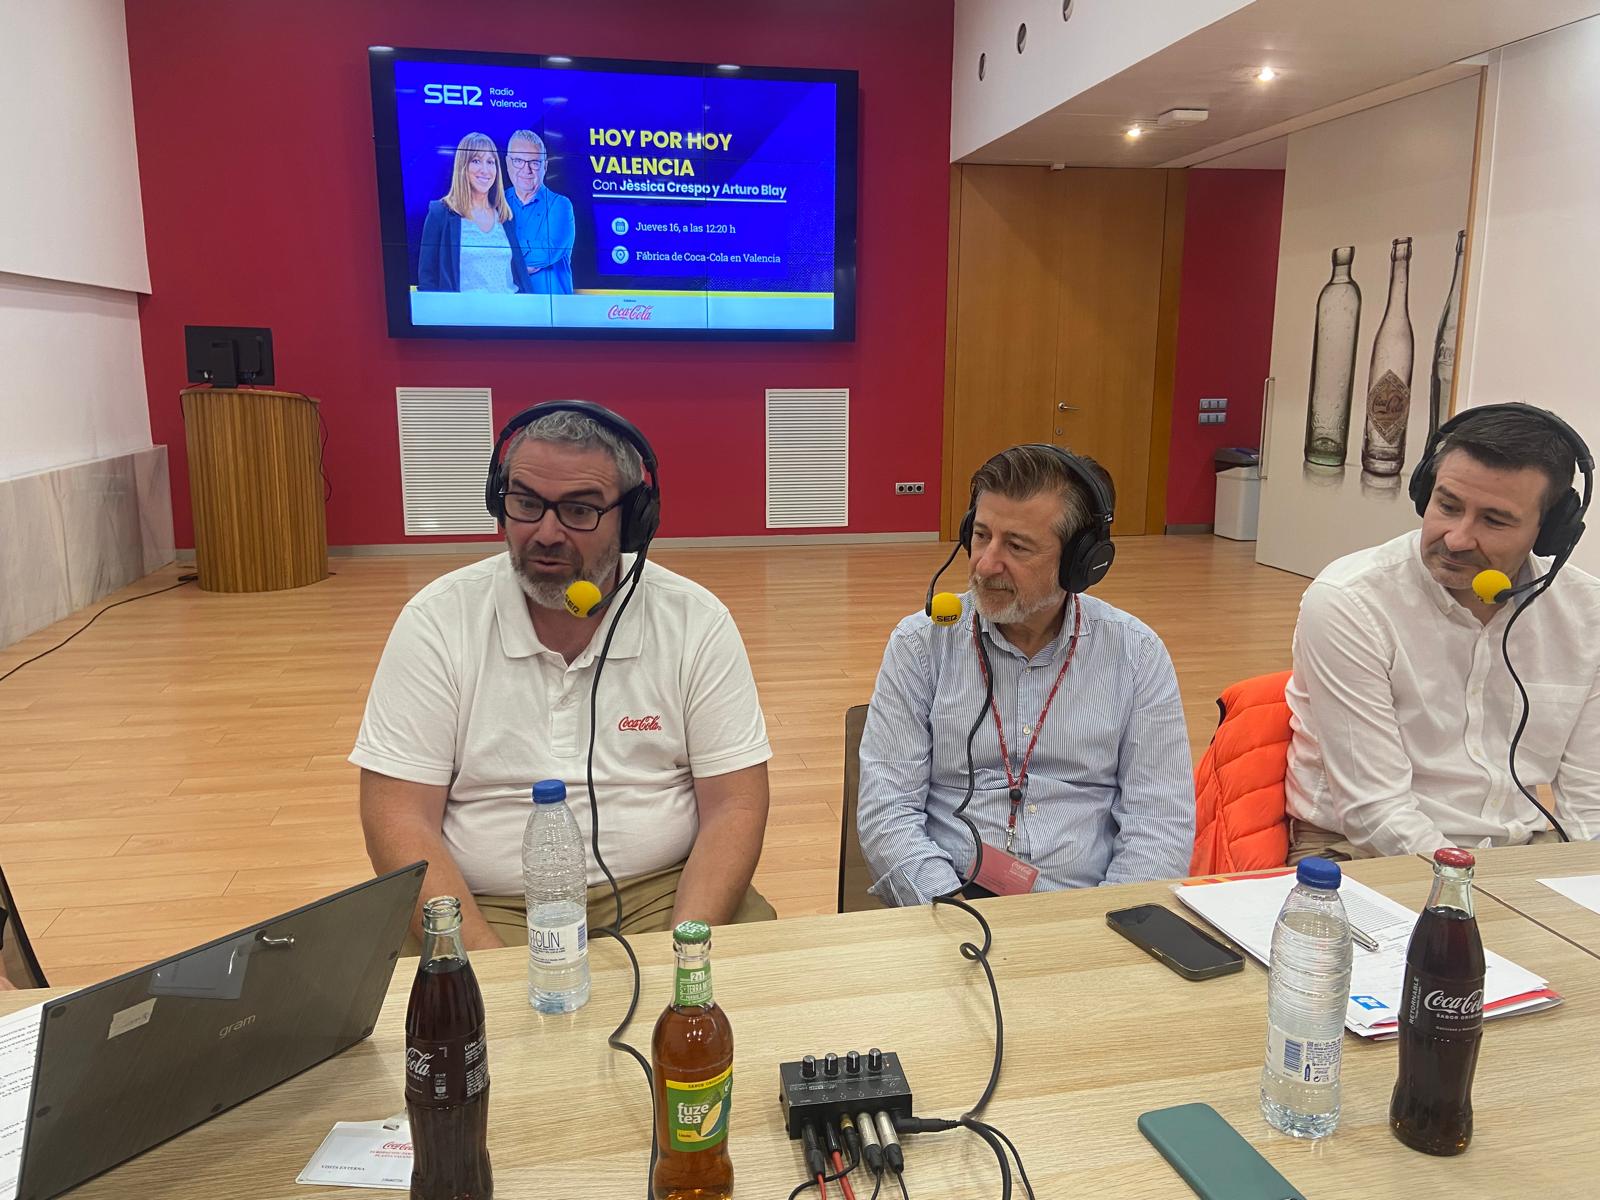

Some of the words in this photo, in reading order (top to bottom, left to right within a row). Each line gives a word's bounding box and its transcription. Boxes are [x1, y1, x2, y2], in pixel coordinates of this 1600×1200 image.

[424, 83, 483, 106] SER
[489, 87, 514, 96] Radio
[489, 99, 528, 109] Valencia
[589, 128, 635, 147] HOY
[640, 130, 682, 149] POR
[687, 132, 732, 151] HOY
[590, 155, 695, 176] VALENCIA
[592, 179, 617, 191] Con
[619, 179, 665, 192] Jèssica
[667, 181, 710, 196] Crespo
[712, 185, 720, 197] y
[722, 184, 759, 195] Arturo
[761, 185, 787, 199] Blay
[635, 222, 668, 232] Jueves
[669, 223, 681, 233] 16,
[690, 223, 703, 233] las
[706, 224, 728, 233] 12:20
[729, 224, 736, 233] h
[636, 251, 670, 261] Fábrica
[671, 251, 683, 261] de
[684, 252, 729, 262] Coca-Cola
[730, 254, 742, 262] en
[743, 253, 781, 263] Valencia
[607, 304, 653, 320] Coca-Cola
[936, 614, 958, 623] SER
[618, 715, 661, 731] Coca-Cola
[1409, 976, 1420, 1024] RETORNABLE
[219, 1014, 256, 1039] gram
[677, 1102, 709, 1115] fuze
[677, 1114, 702, 1124] tea
